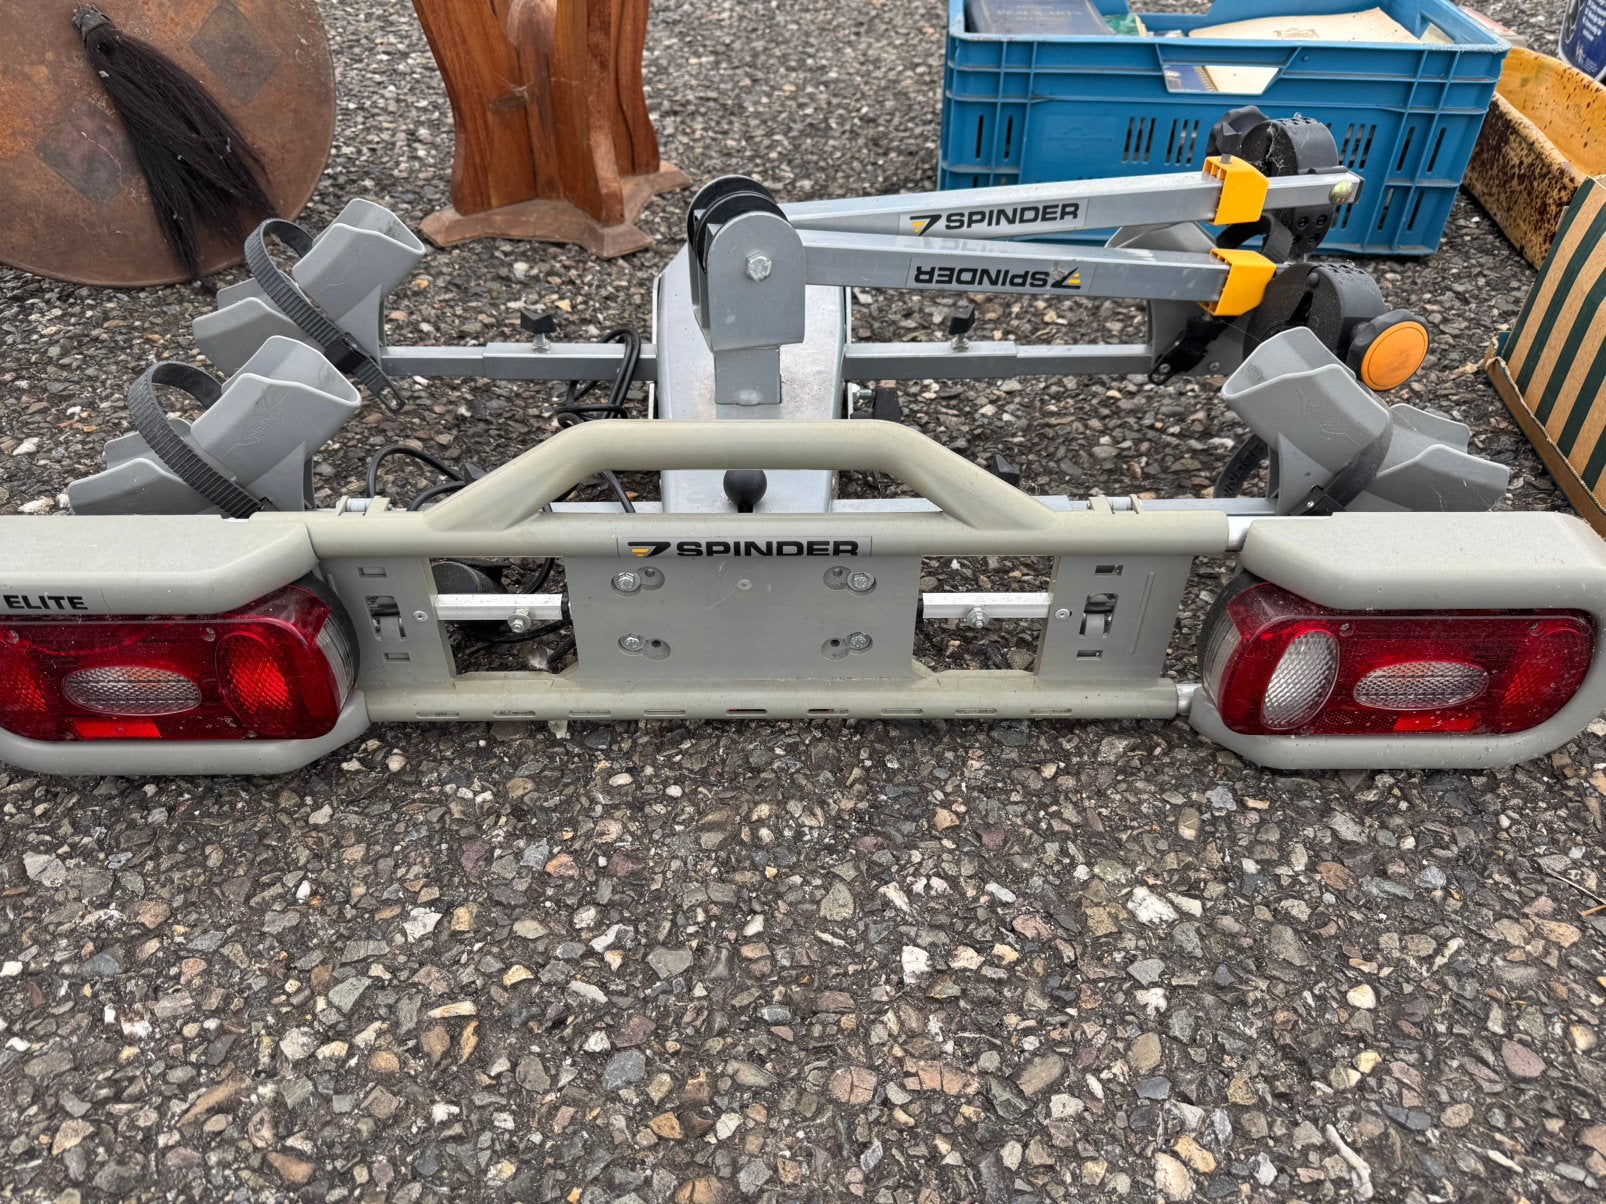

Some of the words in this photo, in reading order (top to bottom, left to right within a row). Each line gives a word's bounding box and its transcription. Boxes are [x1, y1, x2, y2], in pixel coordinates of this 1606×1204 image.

[945, 202, 1080, 230] SPINDER
[914, 266, 1050, 288] SPINDER
[676, 540, 859, 557] SPINDER
[3, 594, 88, 610] ELITE
